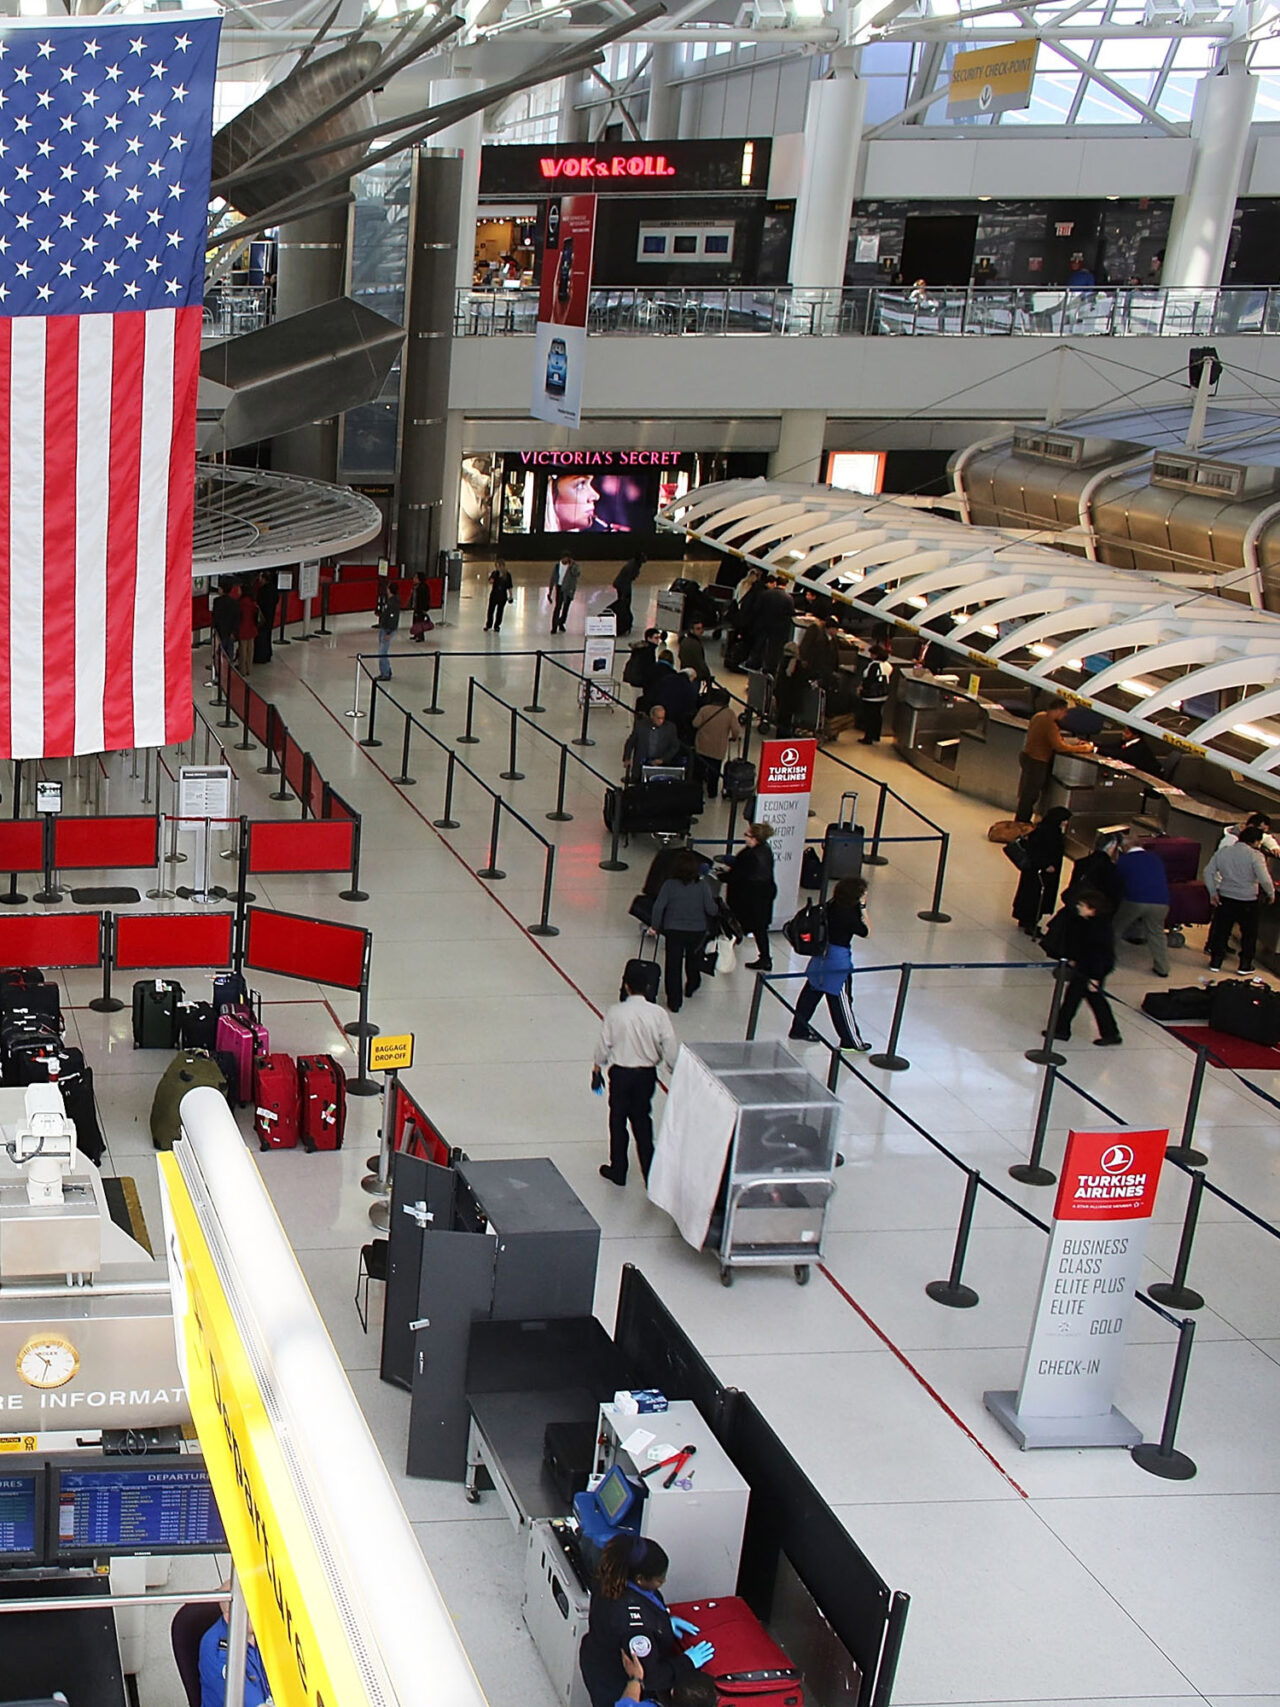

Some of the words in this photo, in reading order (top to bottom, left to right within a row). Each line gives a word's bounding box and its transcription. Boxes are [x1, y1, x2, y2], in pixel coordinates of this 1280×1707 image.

[520, 451, 613, 465] VICTORIA'S
[620, 451, 681, 465] SECRET
[769, 766, 807, 774] TURKISH
[768, 773, 806, 781] AIRLINES
[763, 800, 799, 811] ECONOMY
[375, 1044, 407, 1053] BAGGAGE
[375, 1052, 406, 1061] DROP-OFF
[1078, 1174, 1147, 1187] TURKISH
[1074, 1186, 1144, 1198] AIRLINES
[1062, 1238, 1129, 1256] BUSINESS
[1058, 1258, 1102, 1274] CLASS
[1054, 1278, 1090, 1294] ELITE
[1092, 1277, 1126, 1294] PLUS
[1050, 1299, 1086, 1315] ELITE
[1090, 1318, 1123, 1335] GOLD
[1038, 1359, 1101, 1376] CHECK-IN
[40, 1387, 184, 1408] INFORMAT
[148, 1473, 210, 1482] DEPARTUR
